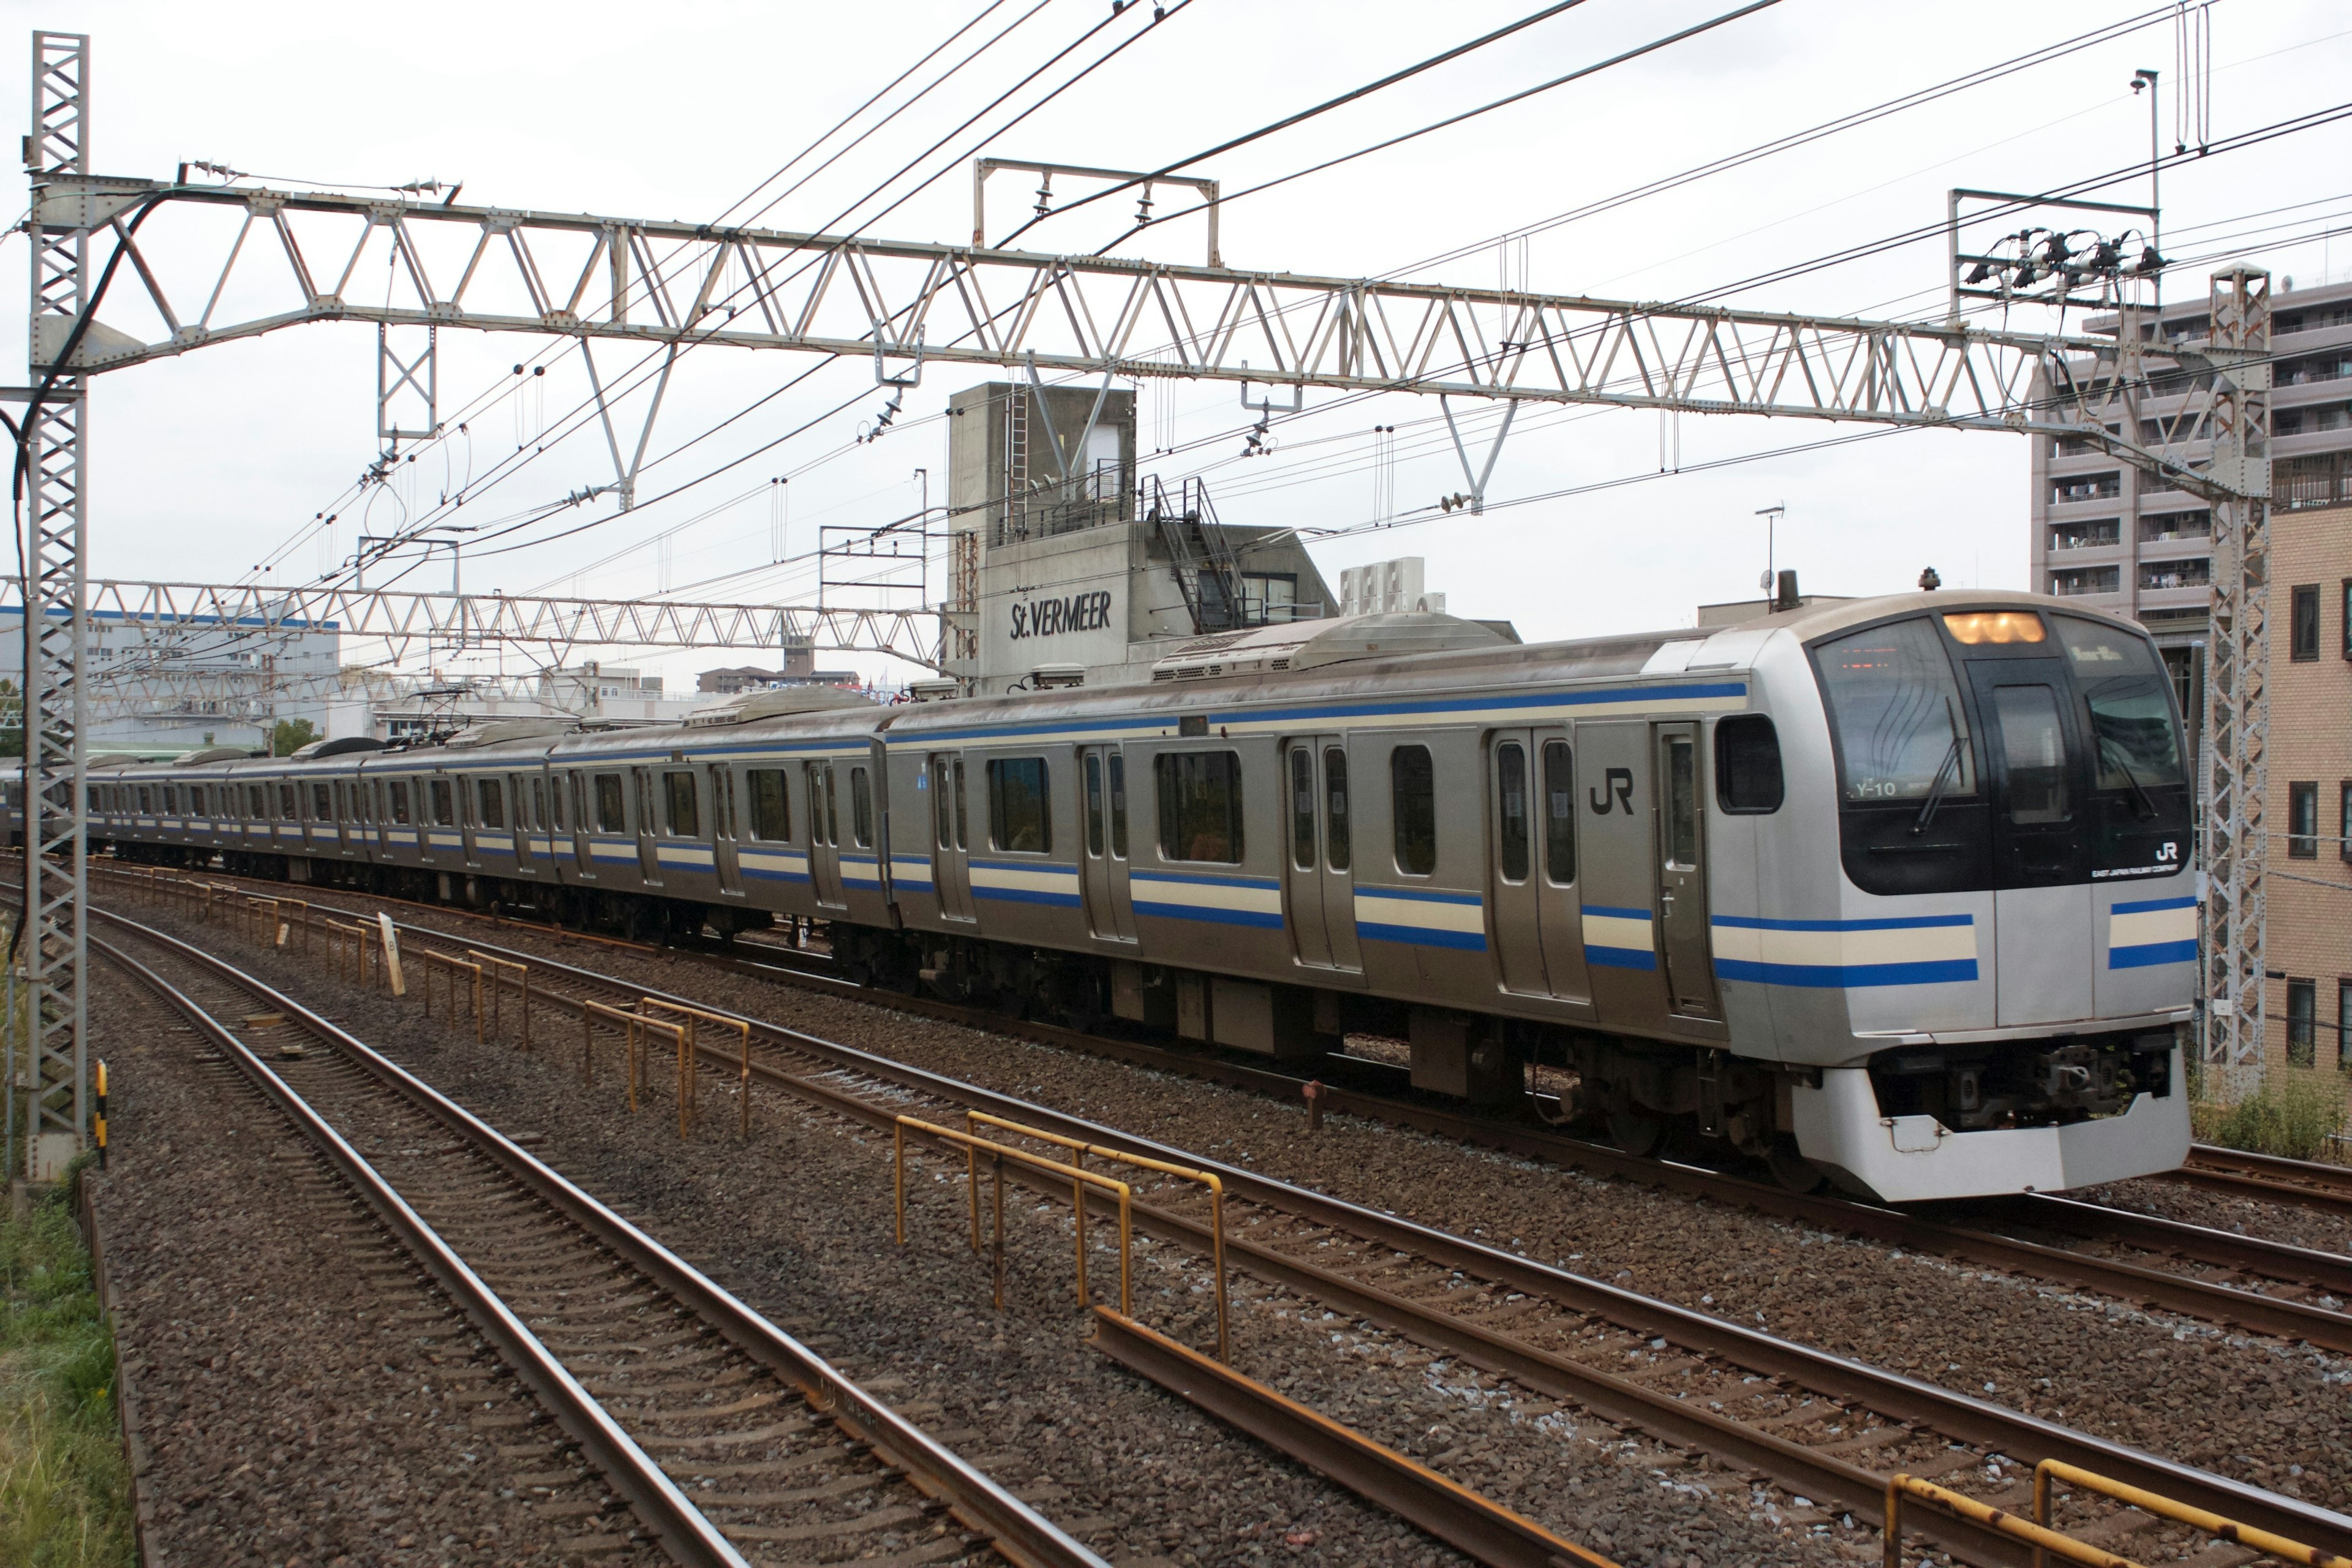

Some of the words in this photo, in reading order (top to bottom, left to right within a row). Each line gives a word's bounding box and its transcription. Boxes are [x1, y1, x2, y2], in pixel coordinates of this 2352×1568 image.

[1590, 767, 1634, 815] JR
[1856, 782, 1896, 796] Y-10
[2156, 842, 2178, 861] JR
[2092, 869, 2110, 878] EAST
